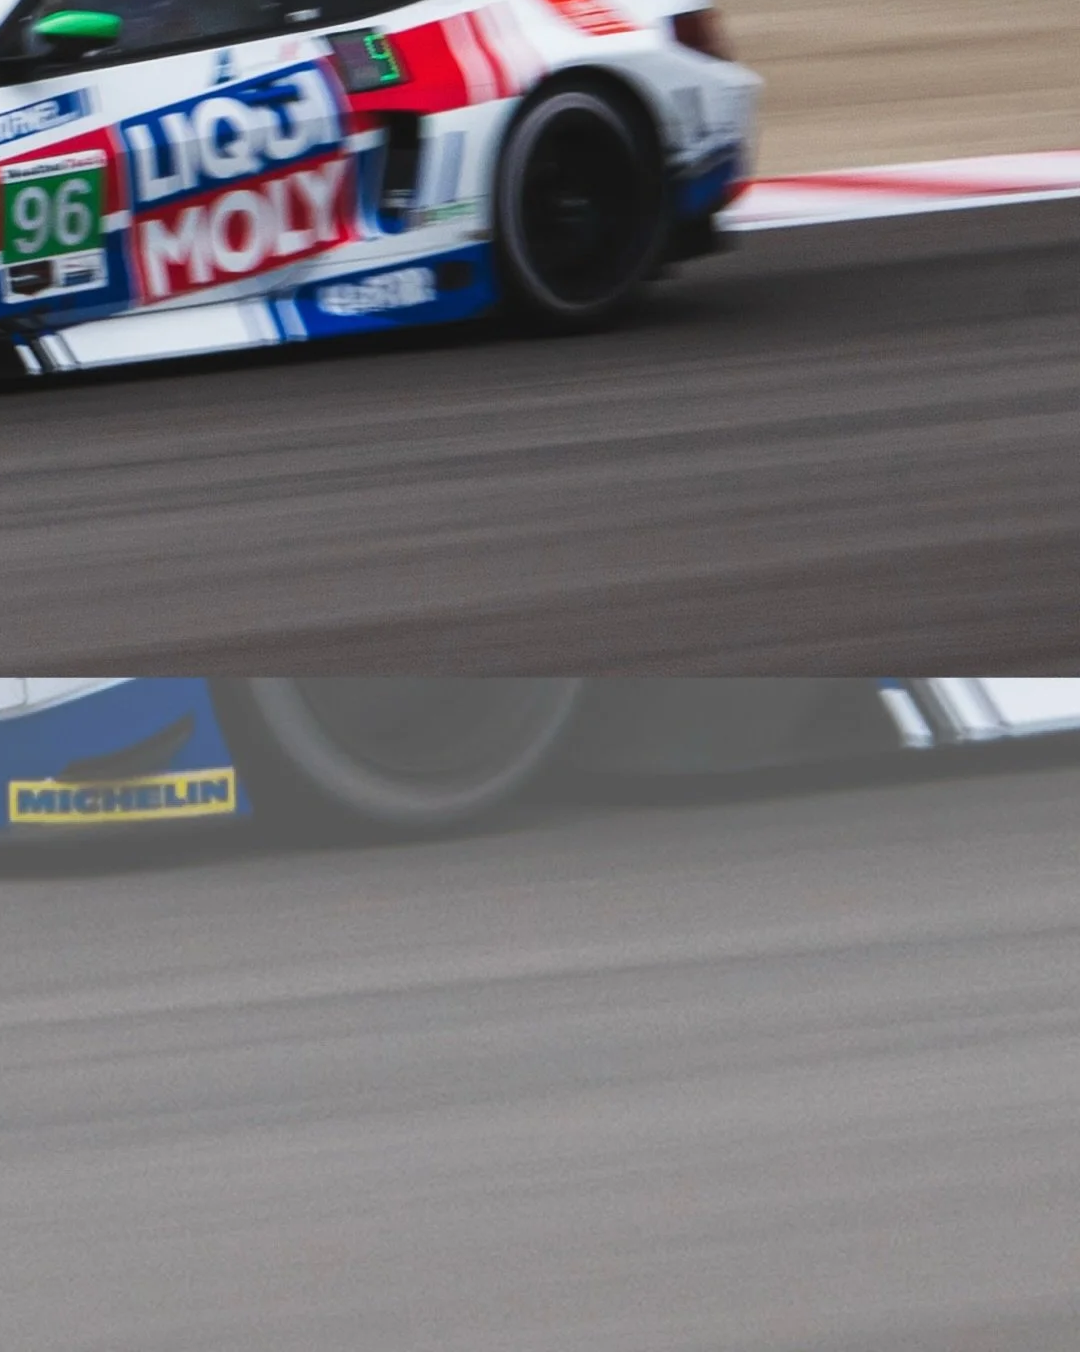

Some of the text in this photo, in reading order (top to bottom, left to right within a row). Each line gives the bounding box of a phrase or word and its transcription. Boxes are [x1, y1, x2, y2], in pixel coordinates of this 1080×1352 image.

[10, 177, 93, 254] 96
[137, 158, 348, 298] MOLY
[18, 777, 229, 814] MICHELIN
